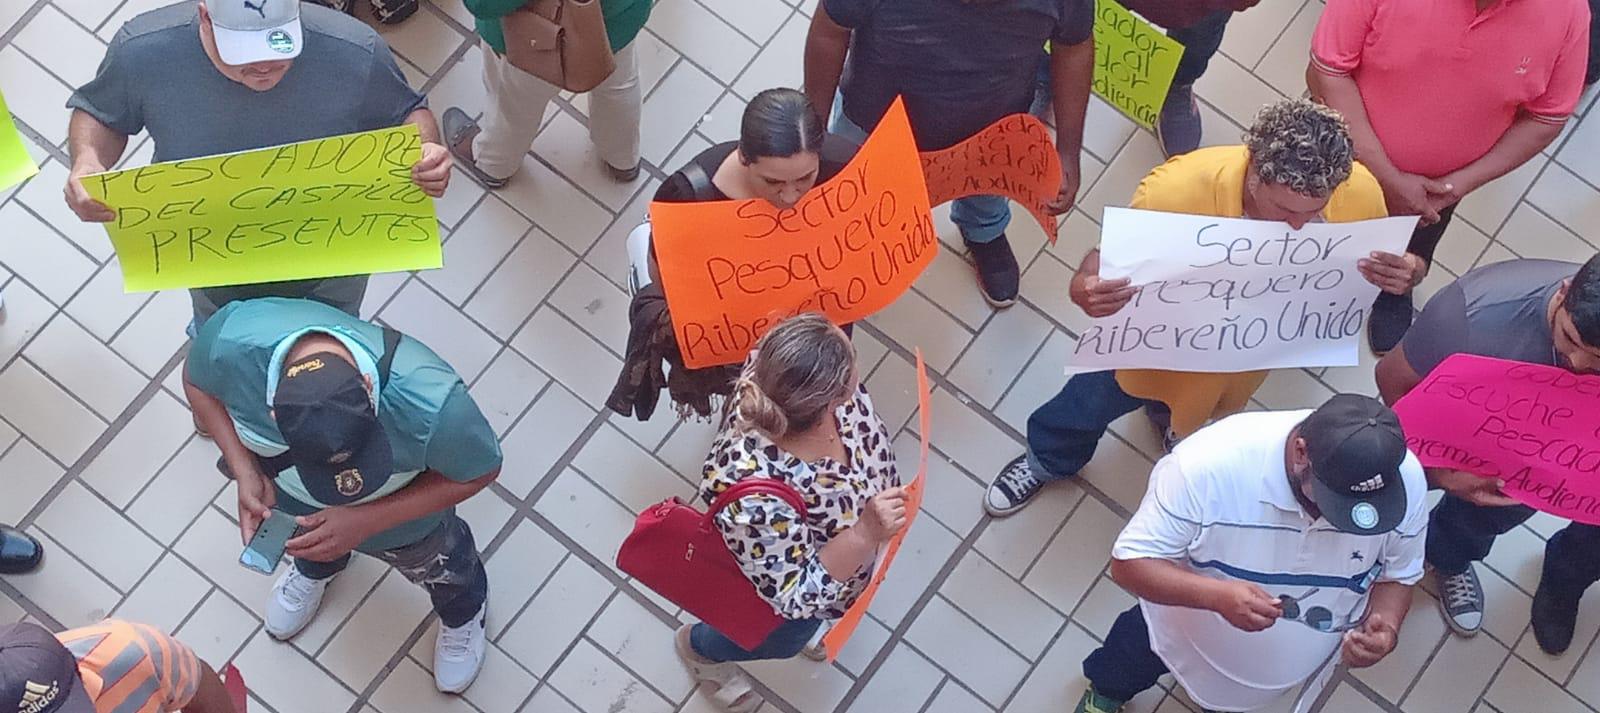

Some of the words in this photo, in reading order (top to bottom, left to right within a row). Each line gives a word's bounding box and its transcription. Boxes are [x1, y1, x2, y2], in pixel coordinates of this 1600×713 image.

[118, 197, 207, 230] DEL
[229, 176, 427, 210] CASTILLO
[736, 160, 870, 239] Sector
[146, 212, 433, 274] PRESENTES
[706, 190, 896, 300] Pesquero
[1189, 223, 1352, 268] Sector
[683, 277, 867, 360] Ribeño
[870, 205, 934, 286] Unido
[1073, 313, 1269, 356] Ribereño
[1278, 296, 1364, 342] Unido
